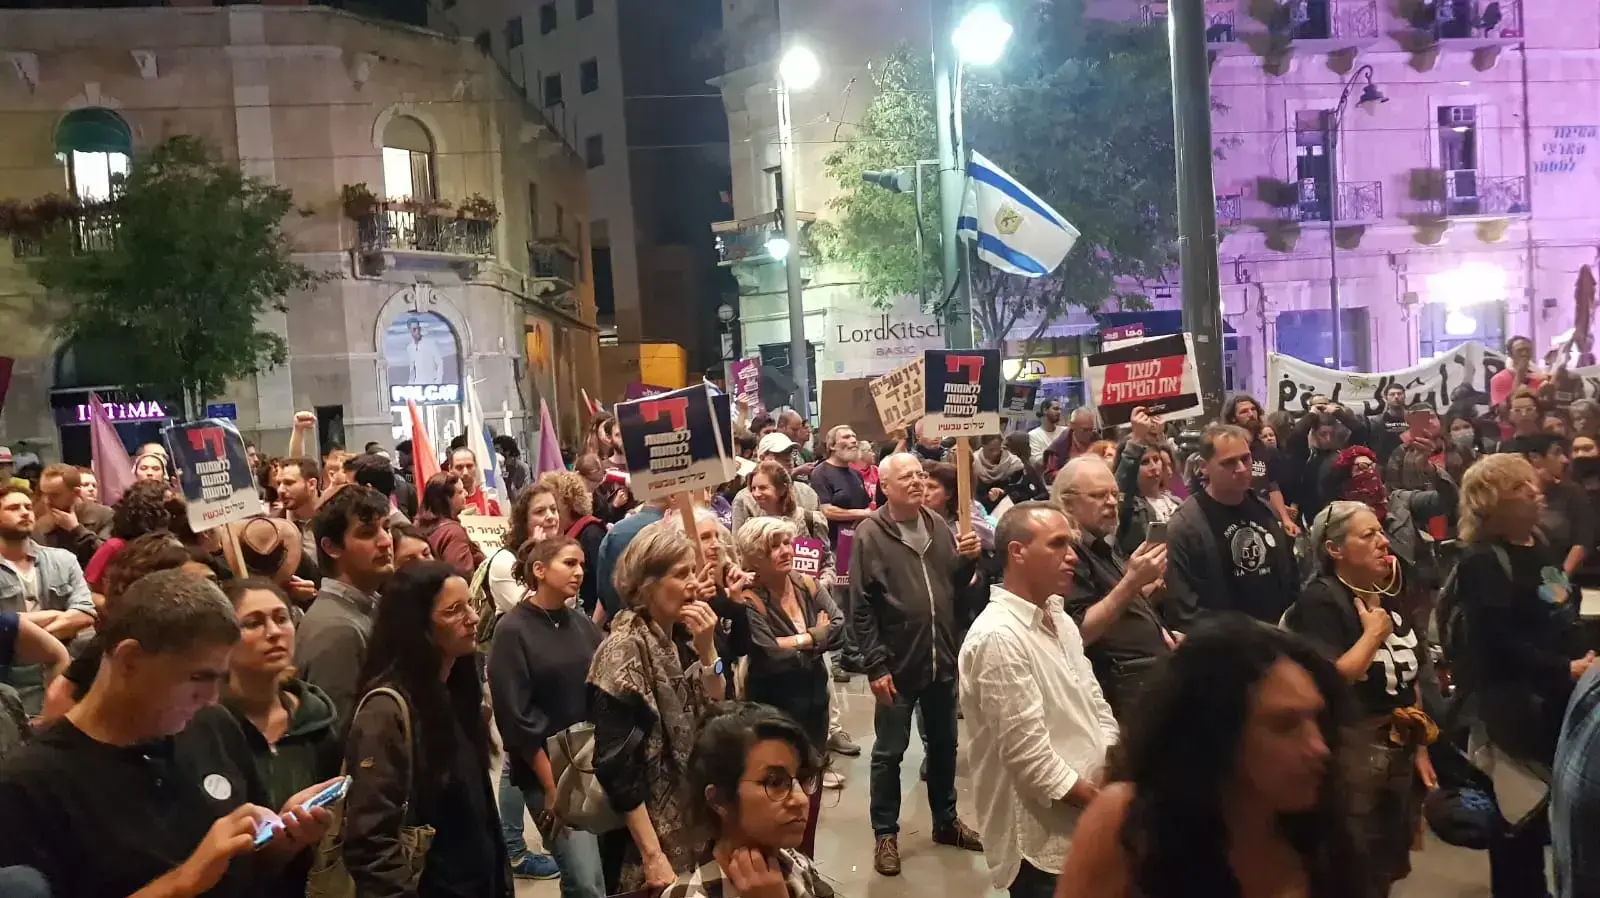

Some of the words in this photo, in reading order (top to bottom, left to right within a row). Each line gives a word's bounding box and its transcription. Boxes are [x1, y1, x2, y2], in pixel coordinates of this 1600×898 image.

[876, 345, 916, 356] BASIC
[944, 354, 985, 385] די
[1125, 359, 1162, 380] לעצור
[885, 378, 921, 402] נגד
[1158, 376, 1177, 394] את
[639, 397, 689, 432] די
[938, 423, 962, 431] עכשיו
[963, 421, 985, 431] שלום
[186, 427, 226, 460] די
